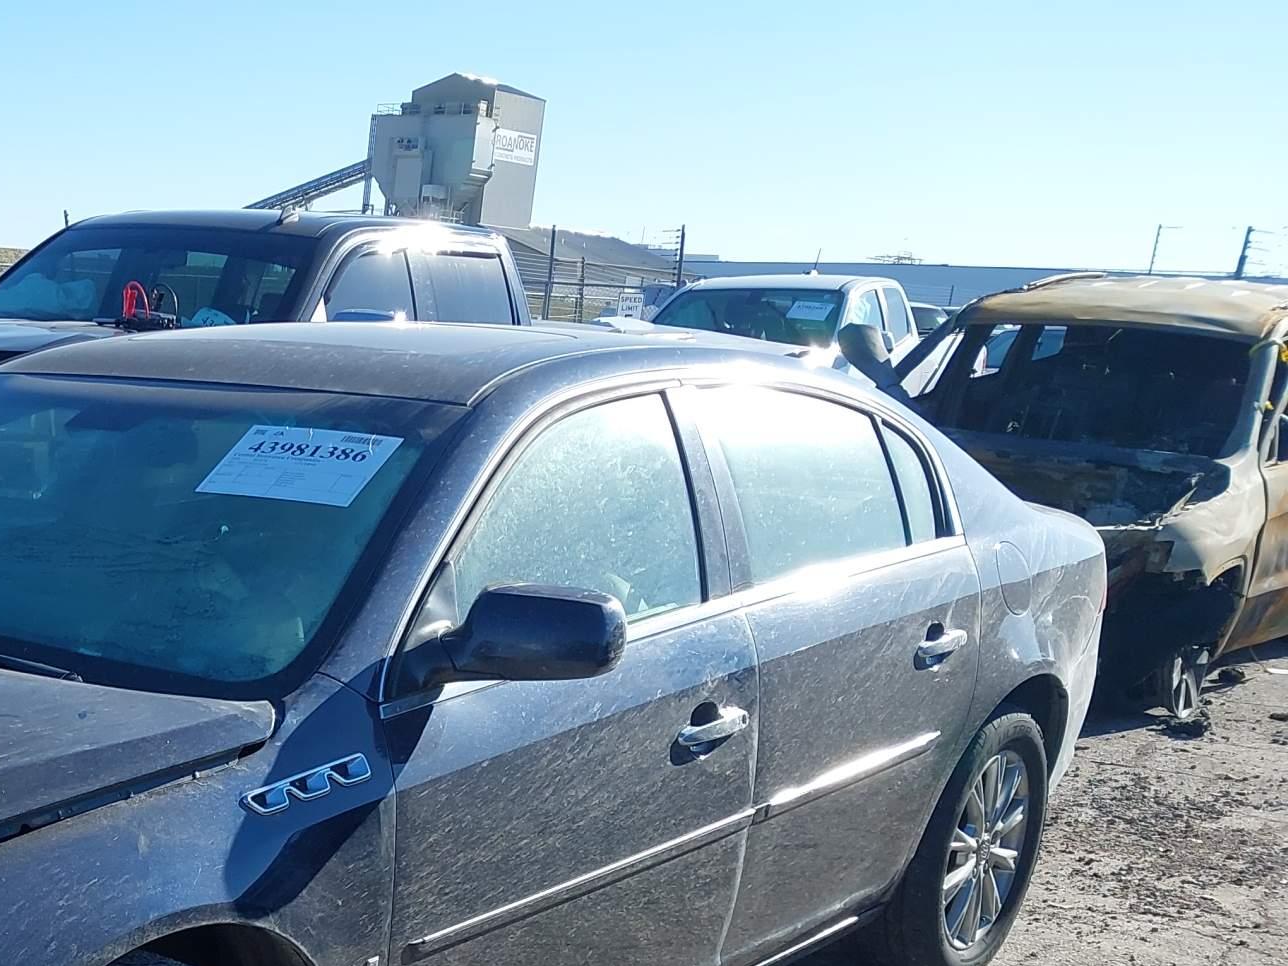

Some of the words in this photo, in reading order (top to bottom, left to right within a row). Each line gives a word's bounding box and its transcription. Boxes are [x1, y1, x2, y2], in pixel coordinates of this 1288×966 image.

[495, 133, 535, 153] ROANOKE
[621, 296, 643, 304] SPEED
[621, 304, 639, 312] LIMIT
[248, 441, 369, 463] 43981386
